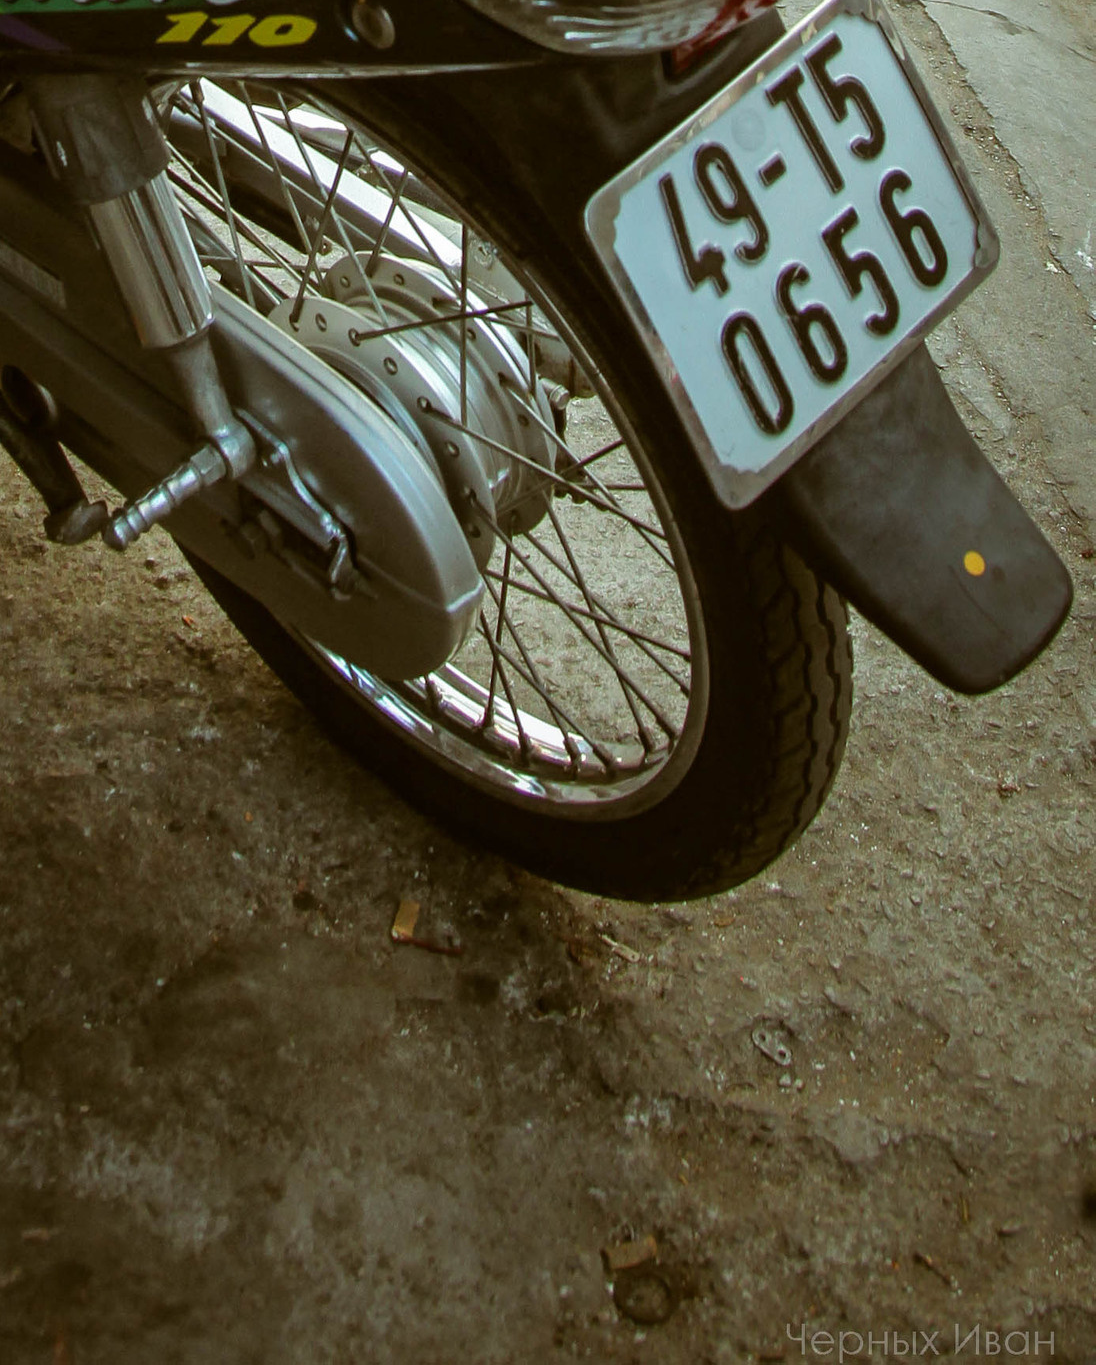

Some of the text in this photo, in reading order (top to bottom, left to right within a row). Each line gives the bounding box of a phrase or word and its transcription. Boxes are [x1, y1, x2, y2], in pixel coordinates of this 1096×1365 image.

[156, 12, 317, 47] 110
[658, 31, 887, 298] 49-T5
[720, 169, 950, 437] 0656
